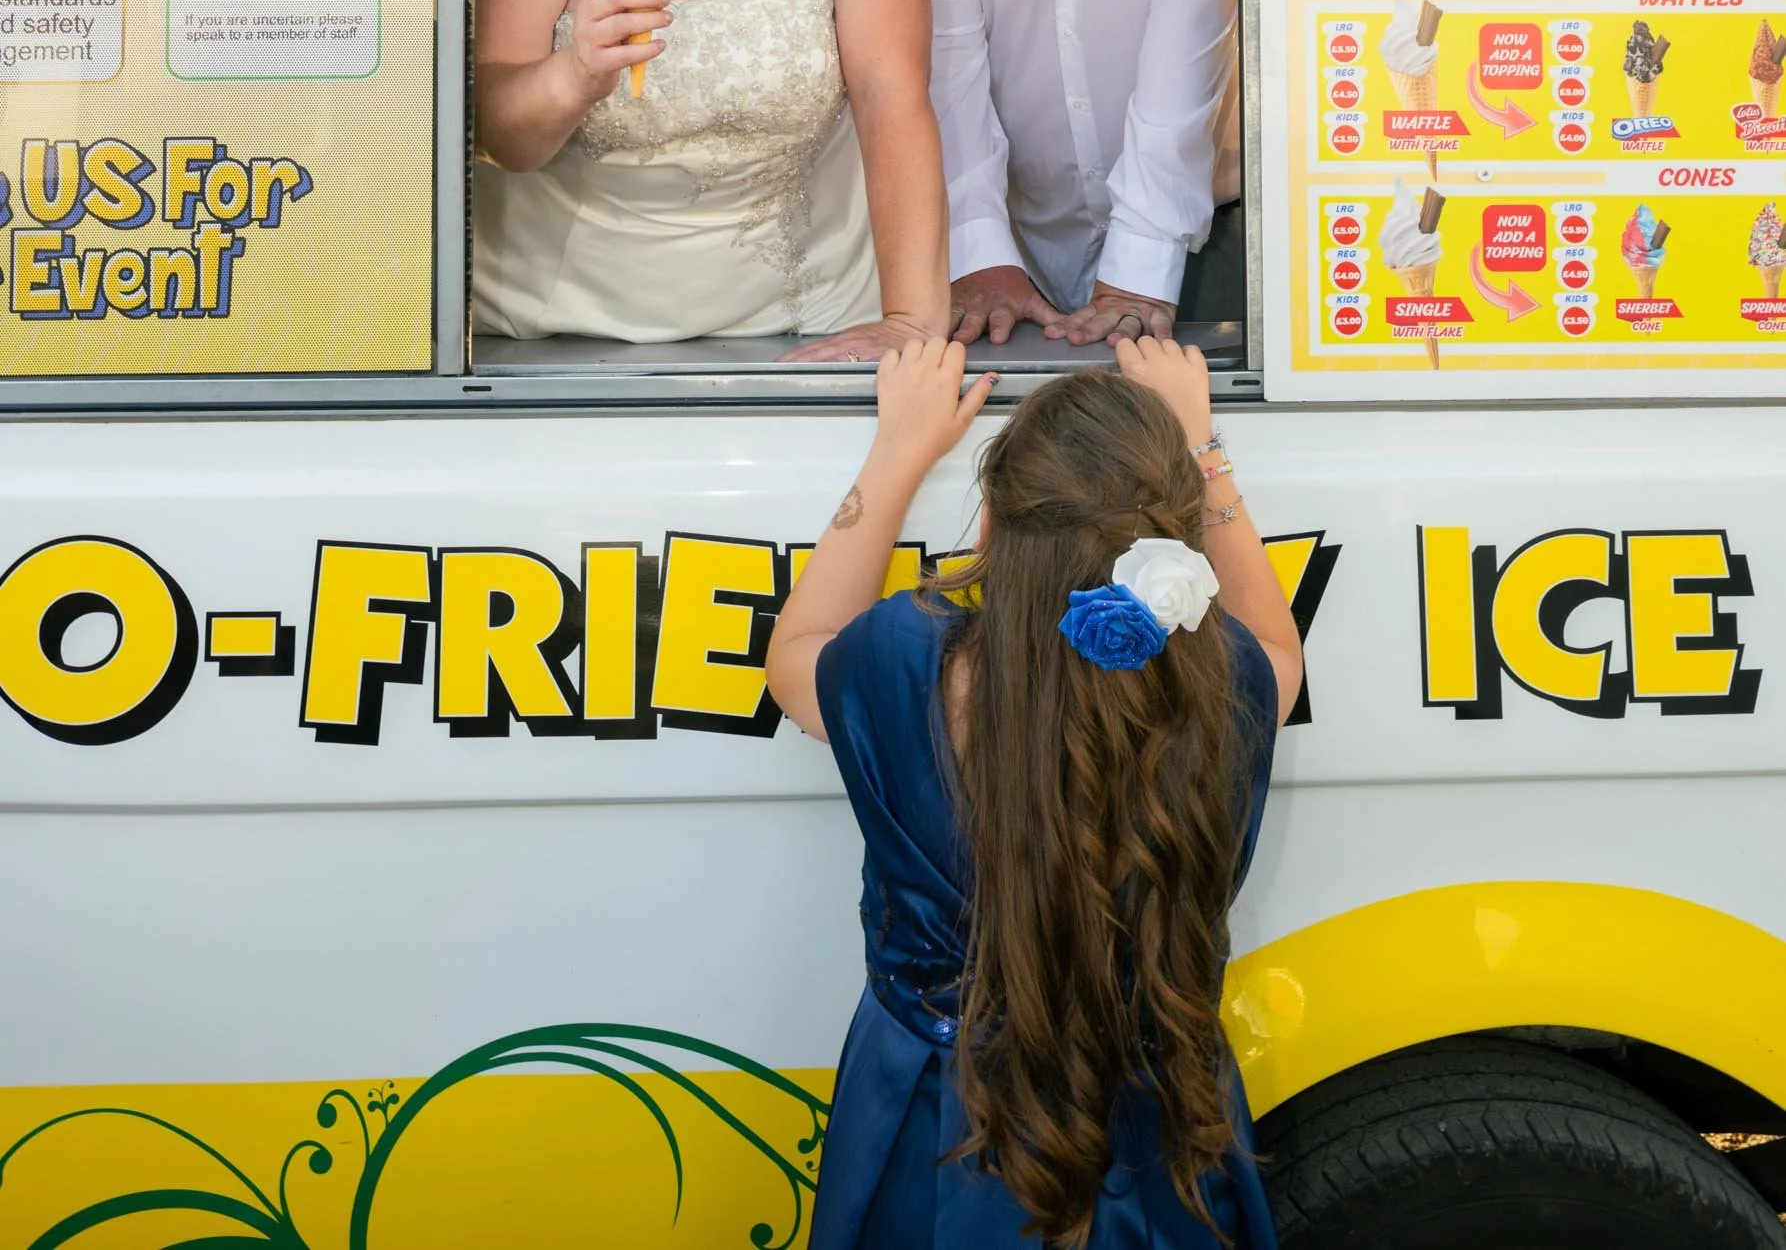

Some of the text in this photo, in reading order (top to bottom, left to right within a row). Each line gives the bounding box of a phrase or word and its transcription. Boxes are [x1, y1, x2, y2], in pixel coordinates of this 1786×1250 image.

[1, 12, 94, 38] d safety
[185, 13, 362, 30] If you are uncertain please
[1334, 22, 1354, 32] LRG
[1560, 21, 1580, 30] LRG
[186, 29, 225, 42] speak
[229, 30, 241, 40] to
[256, 28, 310, 40] member
[314, 28, 327, 39] of
[1493, 32, 1528, 47] NOW
[1488, 48, 1533, 62] ADD A
[1334, 68, 1355, 77] REG
[1481, 63, 1541, 78] TOPPING
[1560, 66, 1581, 76] REG
[1335, 113, 1359, 122] KIDS
[1560, 111, 1585, 120] KIDS
[1736, 106, 1760, 119] Lotus
[1390, 115, 1452, 130] WAFFLE
[1612, 115, 1673, 137] OREO
[1389, 138, 1459, 151] WITH FLAKE
[1621, 140, 1665, 152] WAFFLE
[1745, 141, 1786, 151] WAFFLE
[162, 136, 314, 230] For
[1657, 167, 1736, 188] CONES
[1335, 204, 1355, 213] LRG
[1563, 203, 1583, 212] LRG
[1496, 214, 1532, 228] NOW
[1333, 226, 1360, 235] £5.00
[1491, 229, 1537, 243] ADD A
[1336, 249, 1357, 258] REG
[1485, 245, 1545, 260] TOPPING
[1565, 248, 1585, 257] REG
[9, 221, 247, 320] Event
[1334, 271, 1361, 280] £4.00
[1336, 295, 1360, 304] KIDS
[1564, 294, 1589, 303] KIDS
[1394, 301, 1452, 317] SINGLE
[1617, 301, 1674, 314] SHERBET
[1335, 316, 1362, 326] £3.00
[1631, 320, 1661, 332] CONE
[1757, 321, 1786, 331] CONE
[1392, 325, 1463, 338] WITH FLAKE
[0, 524, 1761, 746] O-FRIE ICE
